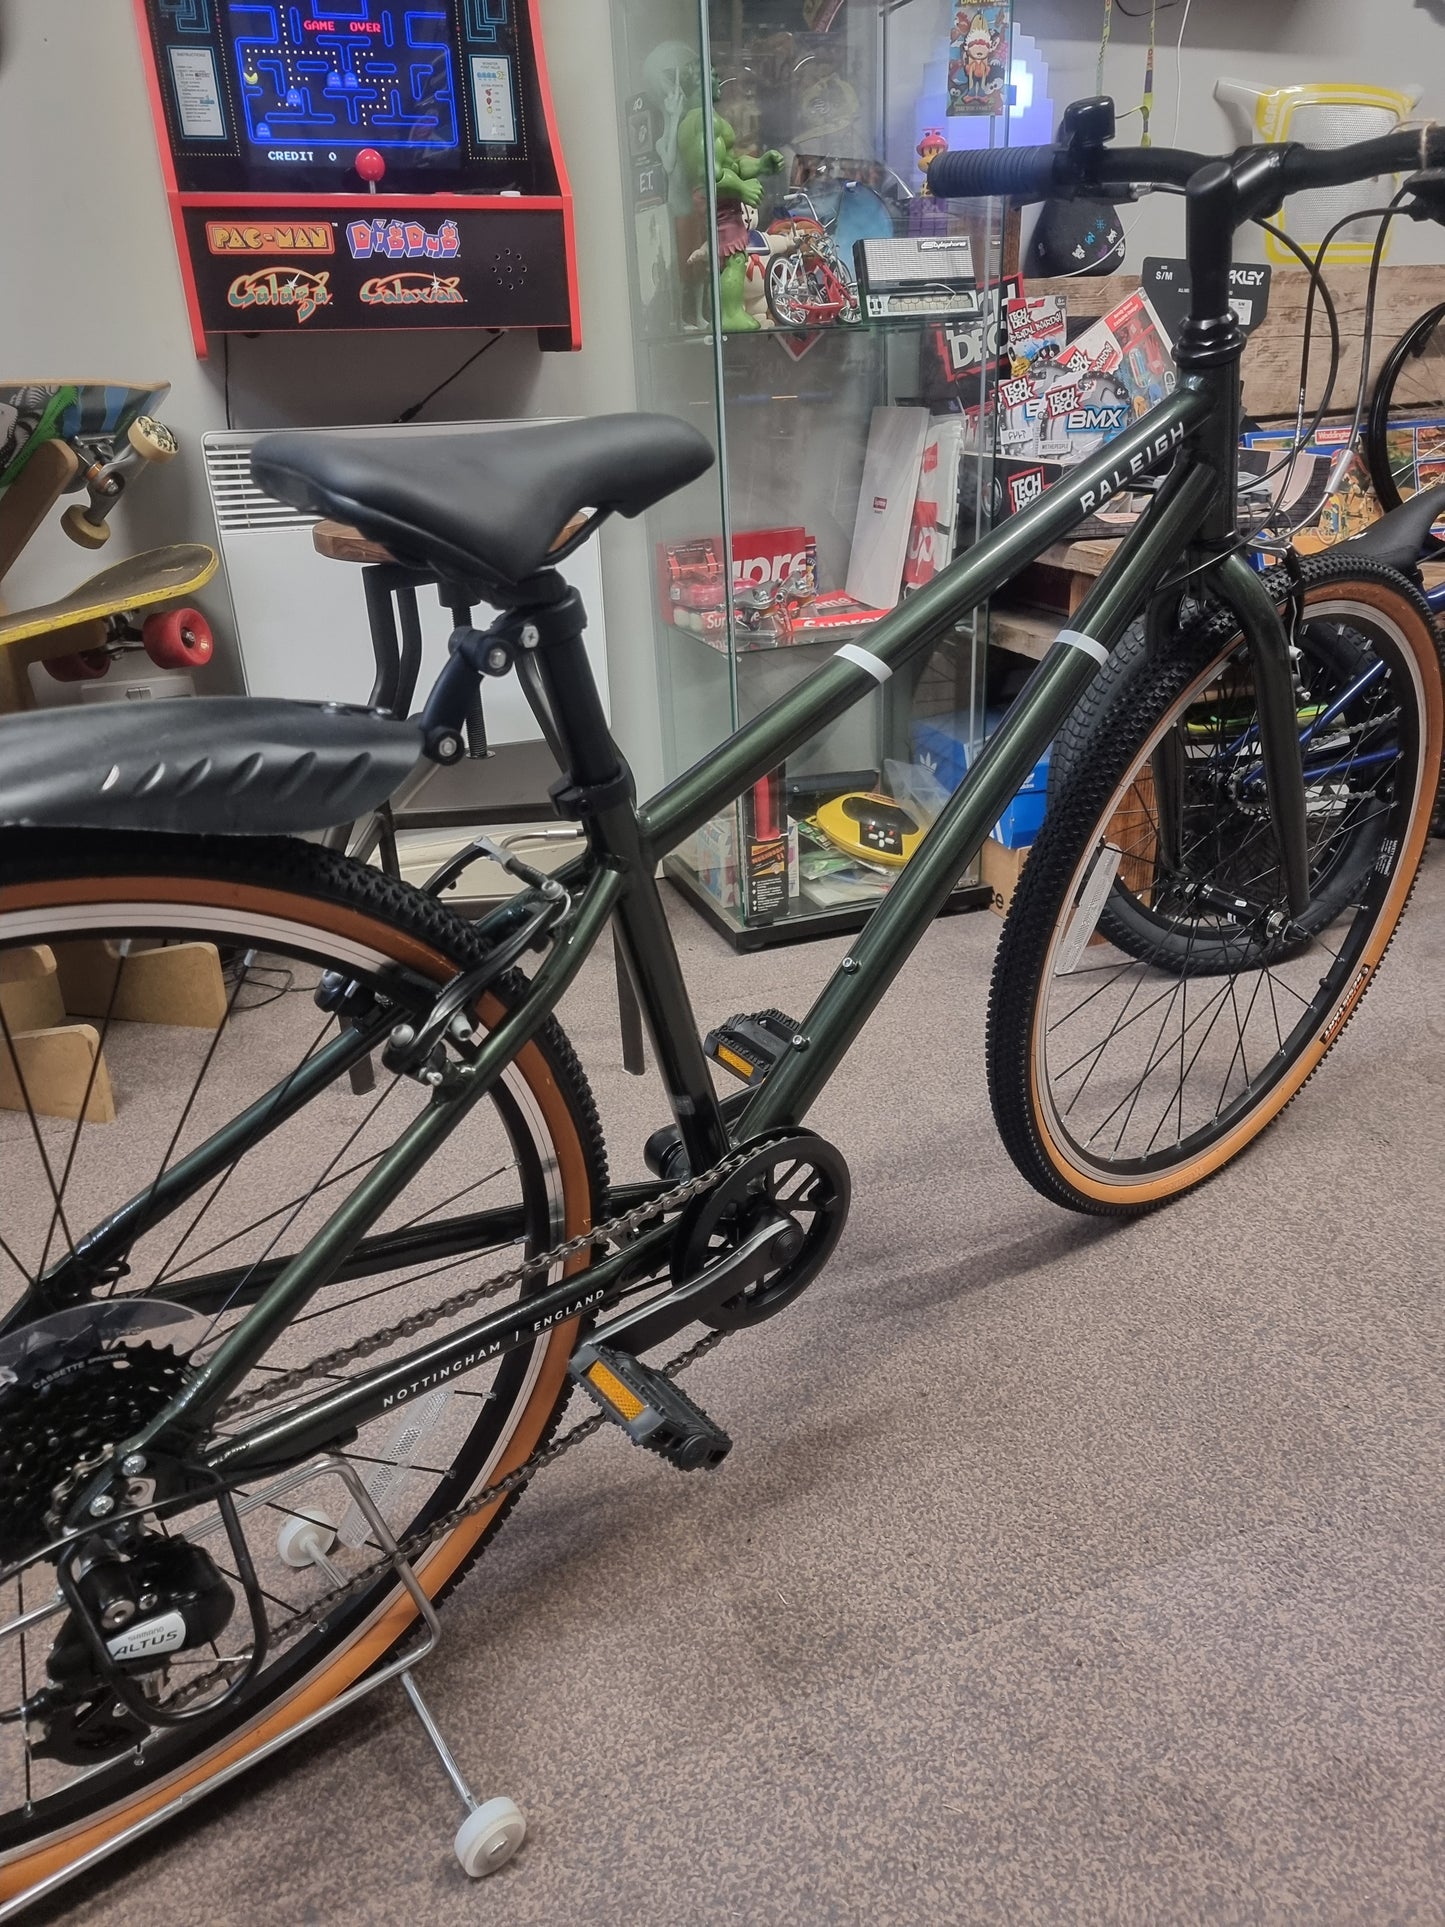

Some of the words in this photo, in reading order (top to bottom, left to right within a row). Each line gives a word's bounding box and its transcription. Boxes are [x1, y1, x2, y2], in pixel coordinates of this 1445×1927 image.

[303, 20, 335, 31] GAME
[349, 21, 381, 33] OVER
[267, 150, 314, 161] CREDIT
[211, 226, 331, 249] PAC-MAN
[1155, 270, 1173, 281] S/M
[228, 266, 333, 323] Galaga
[359, 272, 464, 305] Galaxian
[1008, 307, 1028, 323] TECH
[1012, 315, 1032, 331] DECK
[1001, 377, 1028, 398] TECH
[1006, 384, 1034, 407] DECK
[1048, 388, 1075, 407] TECH
[1116, 387, 1126, 396] 6+
[1051, 395, 1080, 416] DECK
[1067, 408, 1123, 430] BMX
[1079, 421, 1186, 514] RALEIGH
[1011, 472, 1042, 500] TECH
[383, 1341, 501, 1407] NOTTINGHAM
[533, 1288, 605, 1332] ENGLAND
[32, 1361, 86, 1390] CASSETTE
[112, 1630, 178, 1658] ALTUS
[127, 1626, 165, 1641] SHIMANO
